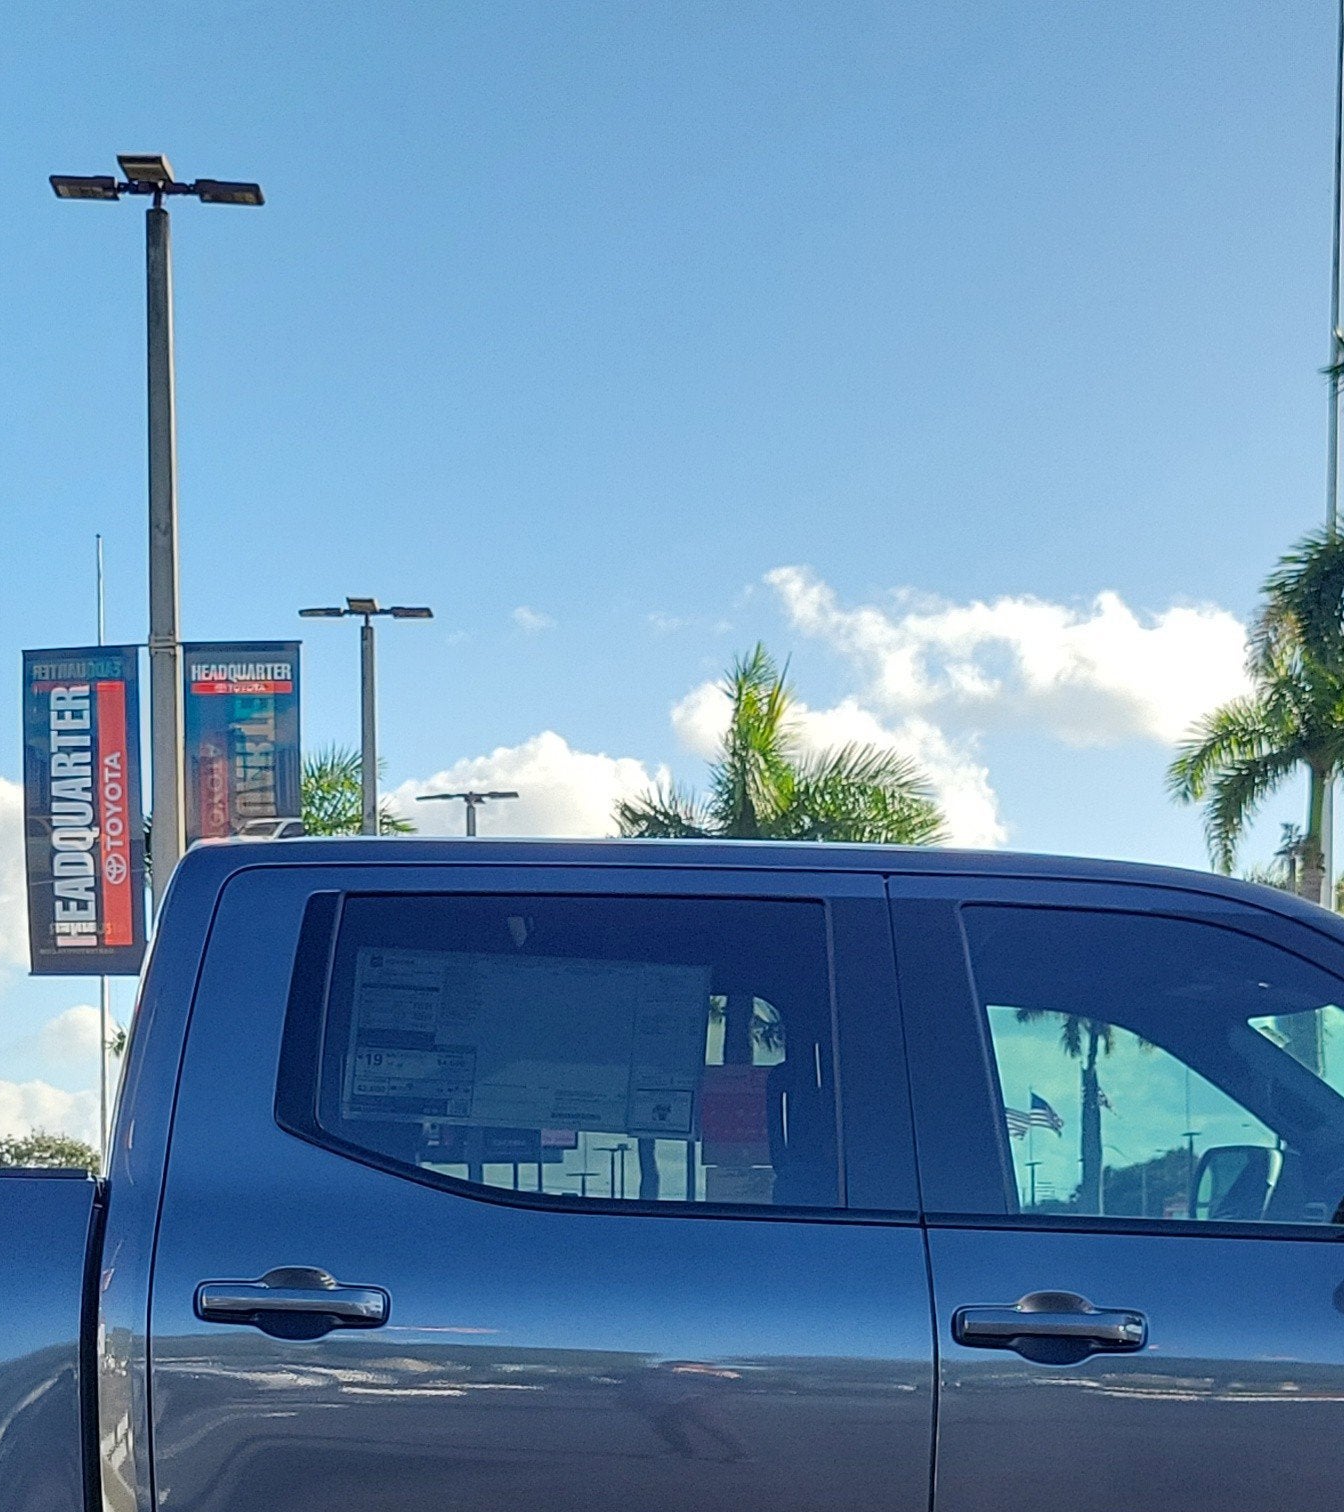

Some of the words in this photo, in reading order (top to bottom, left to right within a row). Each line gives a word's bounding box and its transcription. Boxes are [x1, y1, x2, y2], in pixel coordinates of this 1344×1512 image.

[190, 661, 292, 682] HEADQUARTER
[50, 684, 99, 947] HEADQUARTER
[103, 752, 127, 851] TOYOTA
